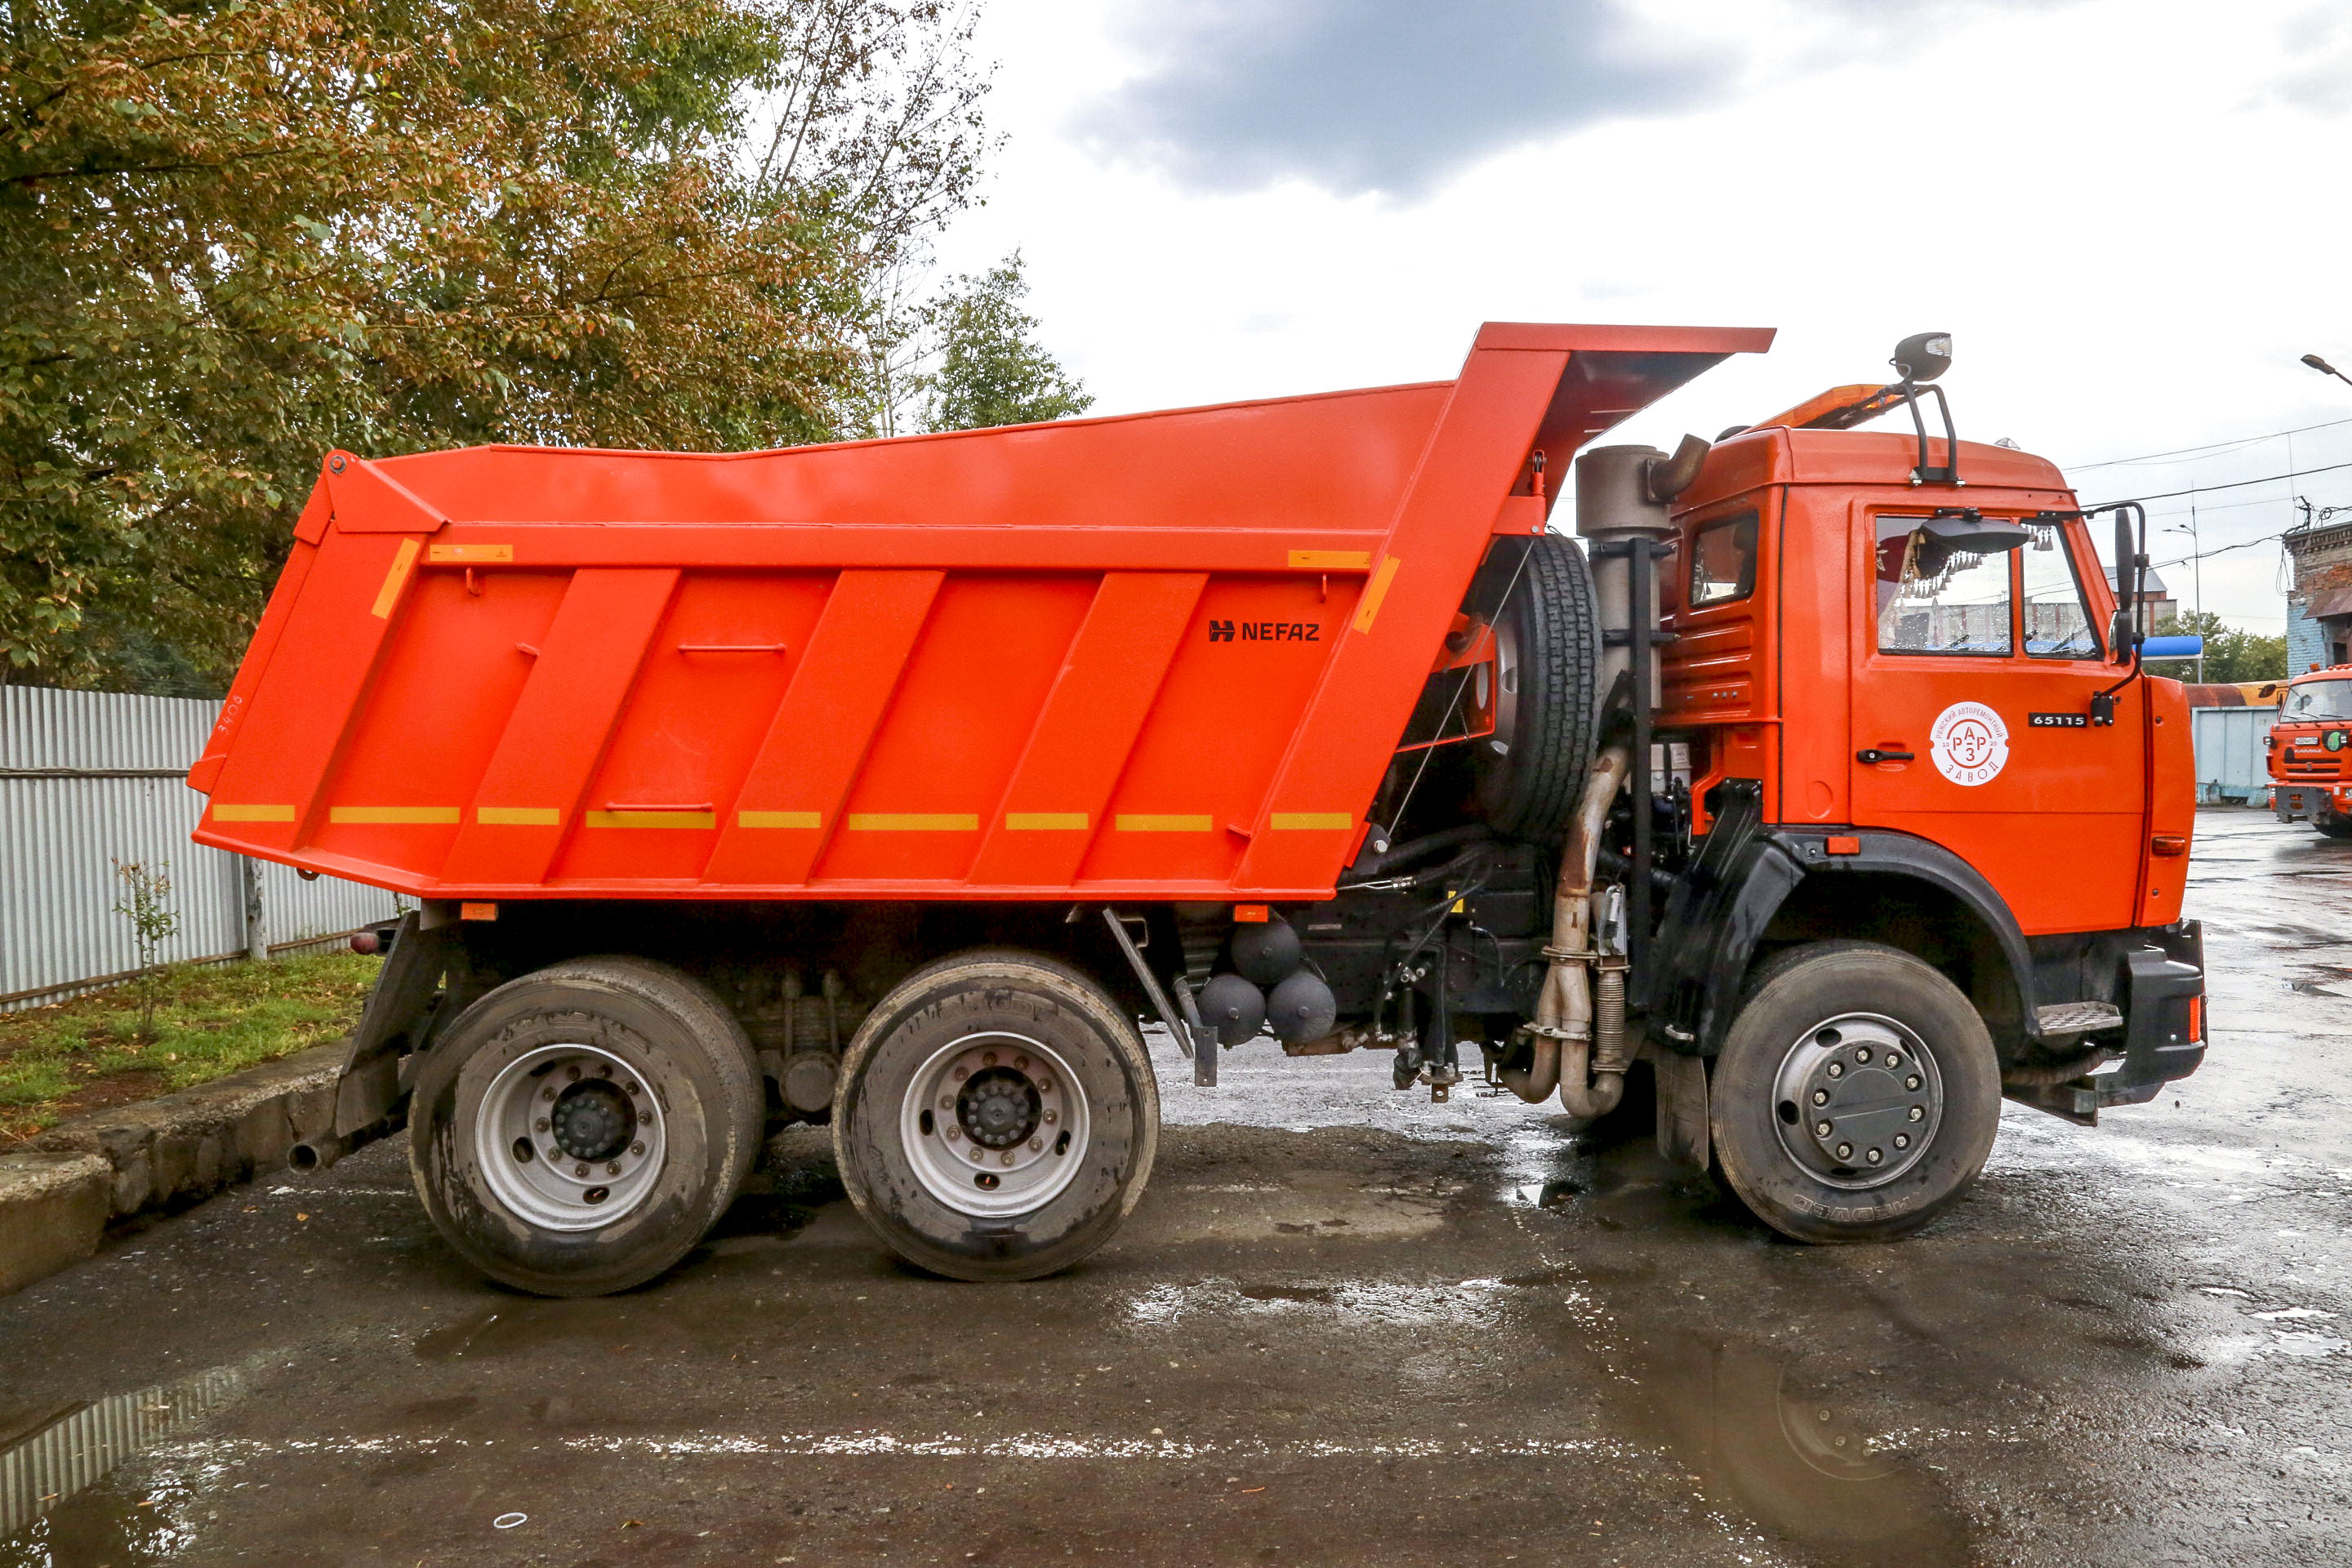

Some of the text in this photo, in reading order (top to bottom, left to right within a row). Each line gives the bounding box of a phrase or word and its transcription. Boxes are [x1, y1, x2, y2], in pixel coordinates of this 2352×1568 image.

[1242, 622, 1320, 641] NEFAZ
[2034, 716, 2084, 725] 65115
[1946, 761, 1998, 782] ЗАВОД
